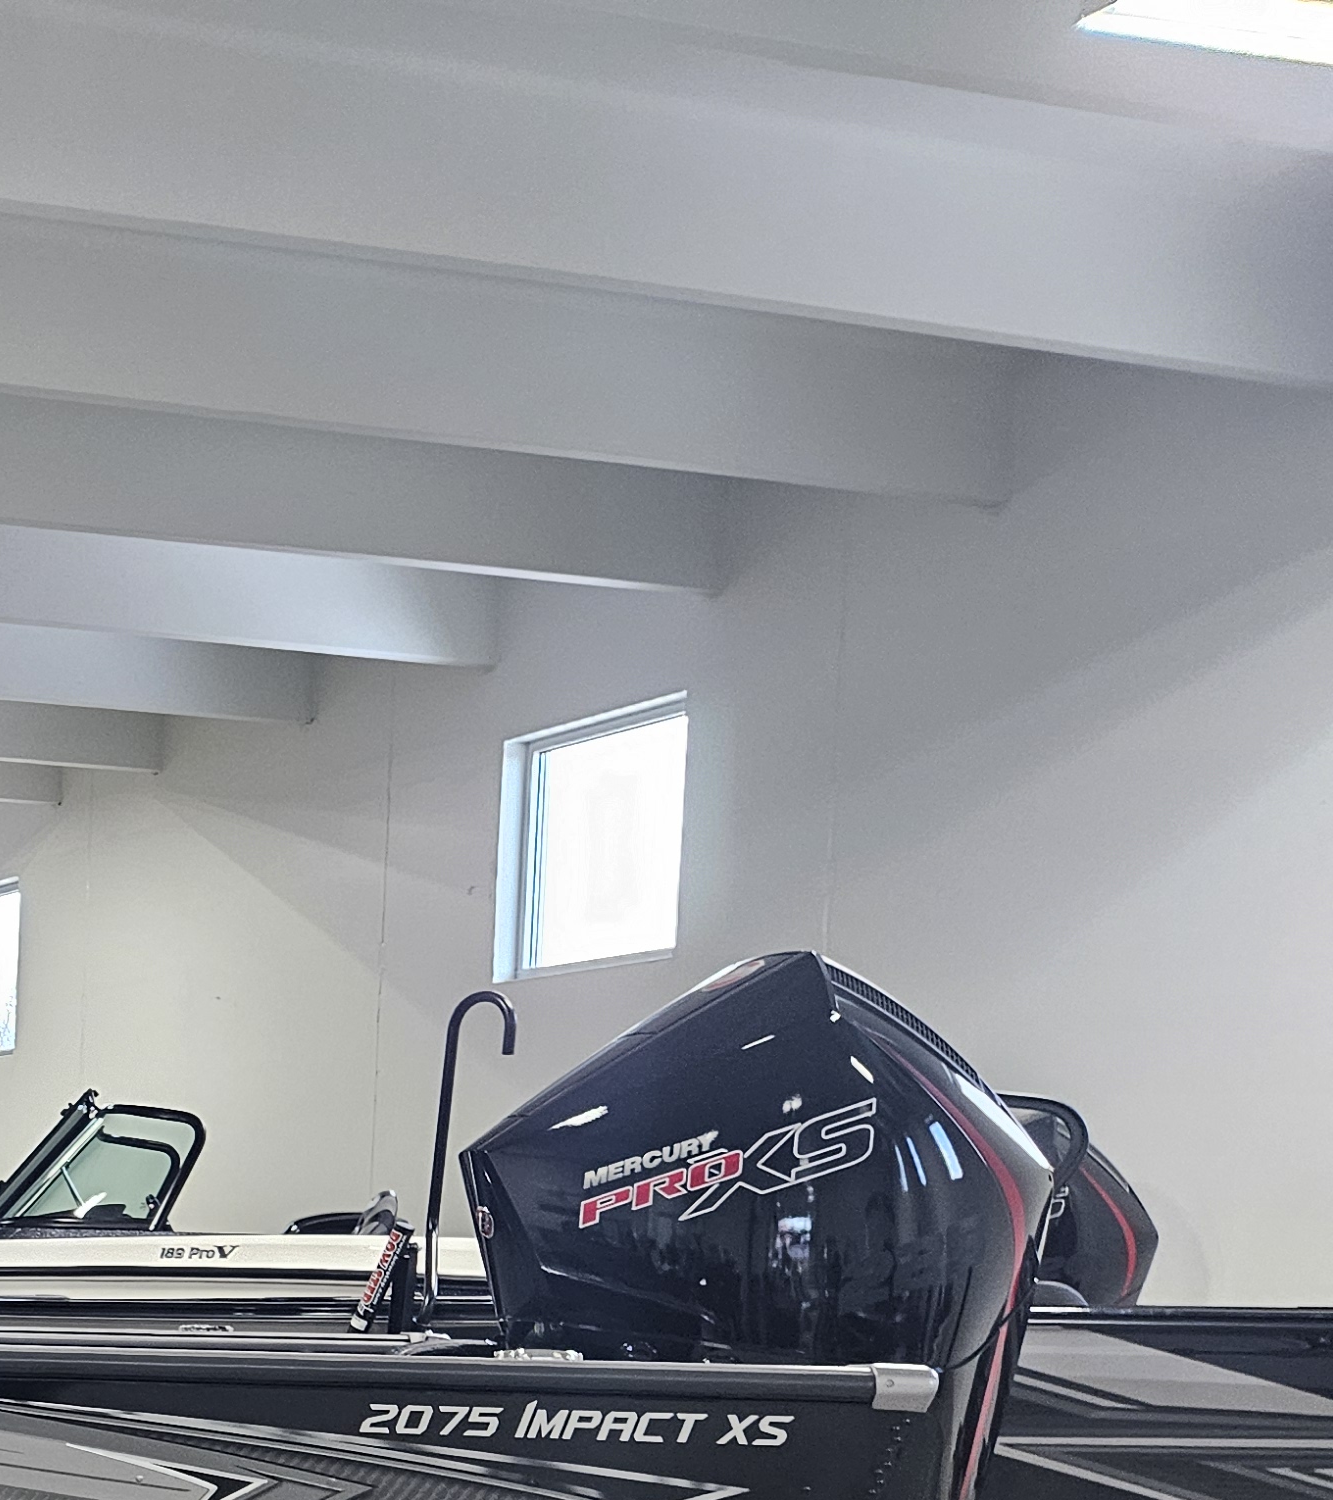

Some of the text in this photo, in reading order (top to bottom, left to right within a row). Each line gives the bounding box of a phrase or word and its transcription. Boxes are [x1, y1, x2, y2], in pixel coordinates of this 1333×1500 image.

[578, 1097, 877, 1229] PRO XS
[583, 1129, 719, 1189] MERCURY
[159, 1247, 185, 1259] 189
[358, 1400, 796, 1447] 2075 IMPACT XS
